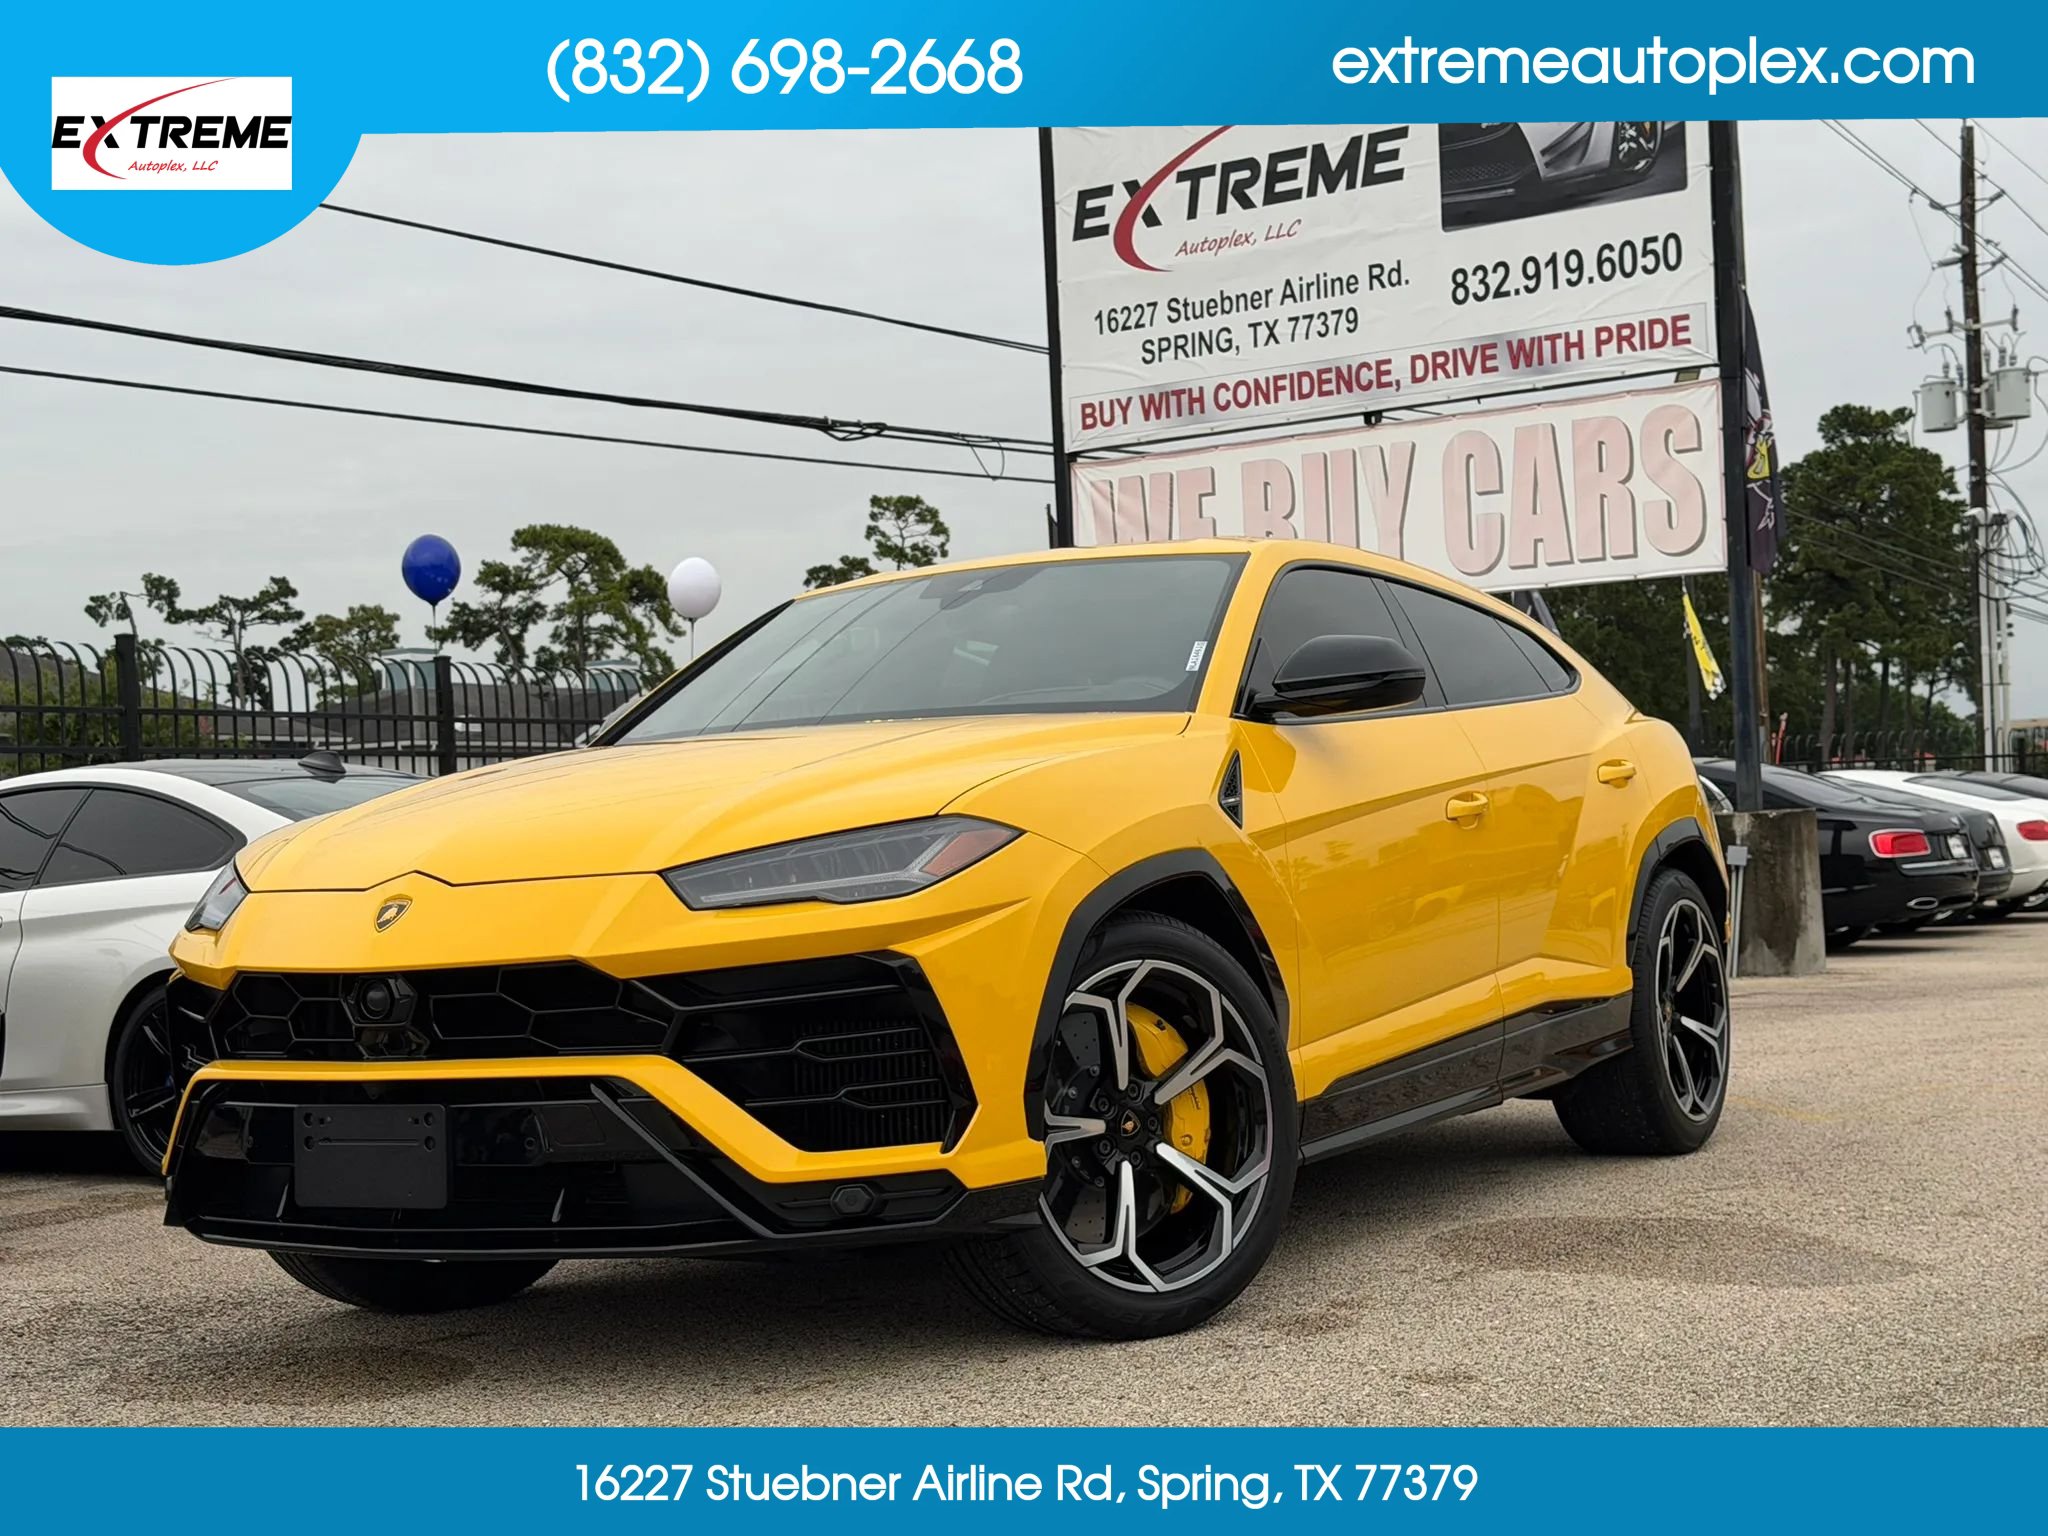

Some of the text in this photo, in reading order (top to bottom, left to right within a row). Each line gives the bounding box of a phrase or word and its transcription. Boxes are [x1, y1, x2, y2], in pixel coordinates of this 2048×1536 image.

[1072, 125, 1410, 242] EXTREME
[1175, 219, 1302, 257] Autoplex, LLC
[1451, 232, 1684, 306] 832.919.6050
[1094, 260, 1411, 335] 16227 Stuebner Airline Rd.
[1080, 313, 1693, 431] BUY WITH CONFIDENCE, DRIVE WITH PRIDE
[1141, 306, 1360, 365] SPRING, TX 77379
[1241, 441, 1417, 561] BUY
[1442, 404, 1708, 577] CARS
